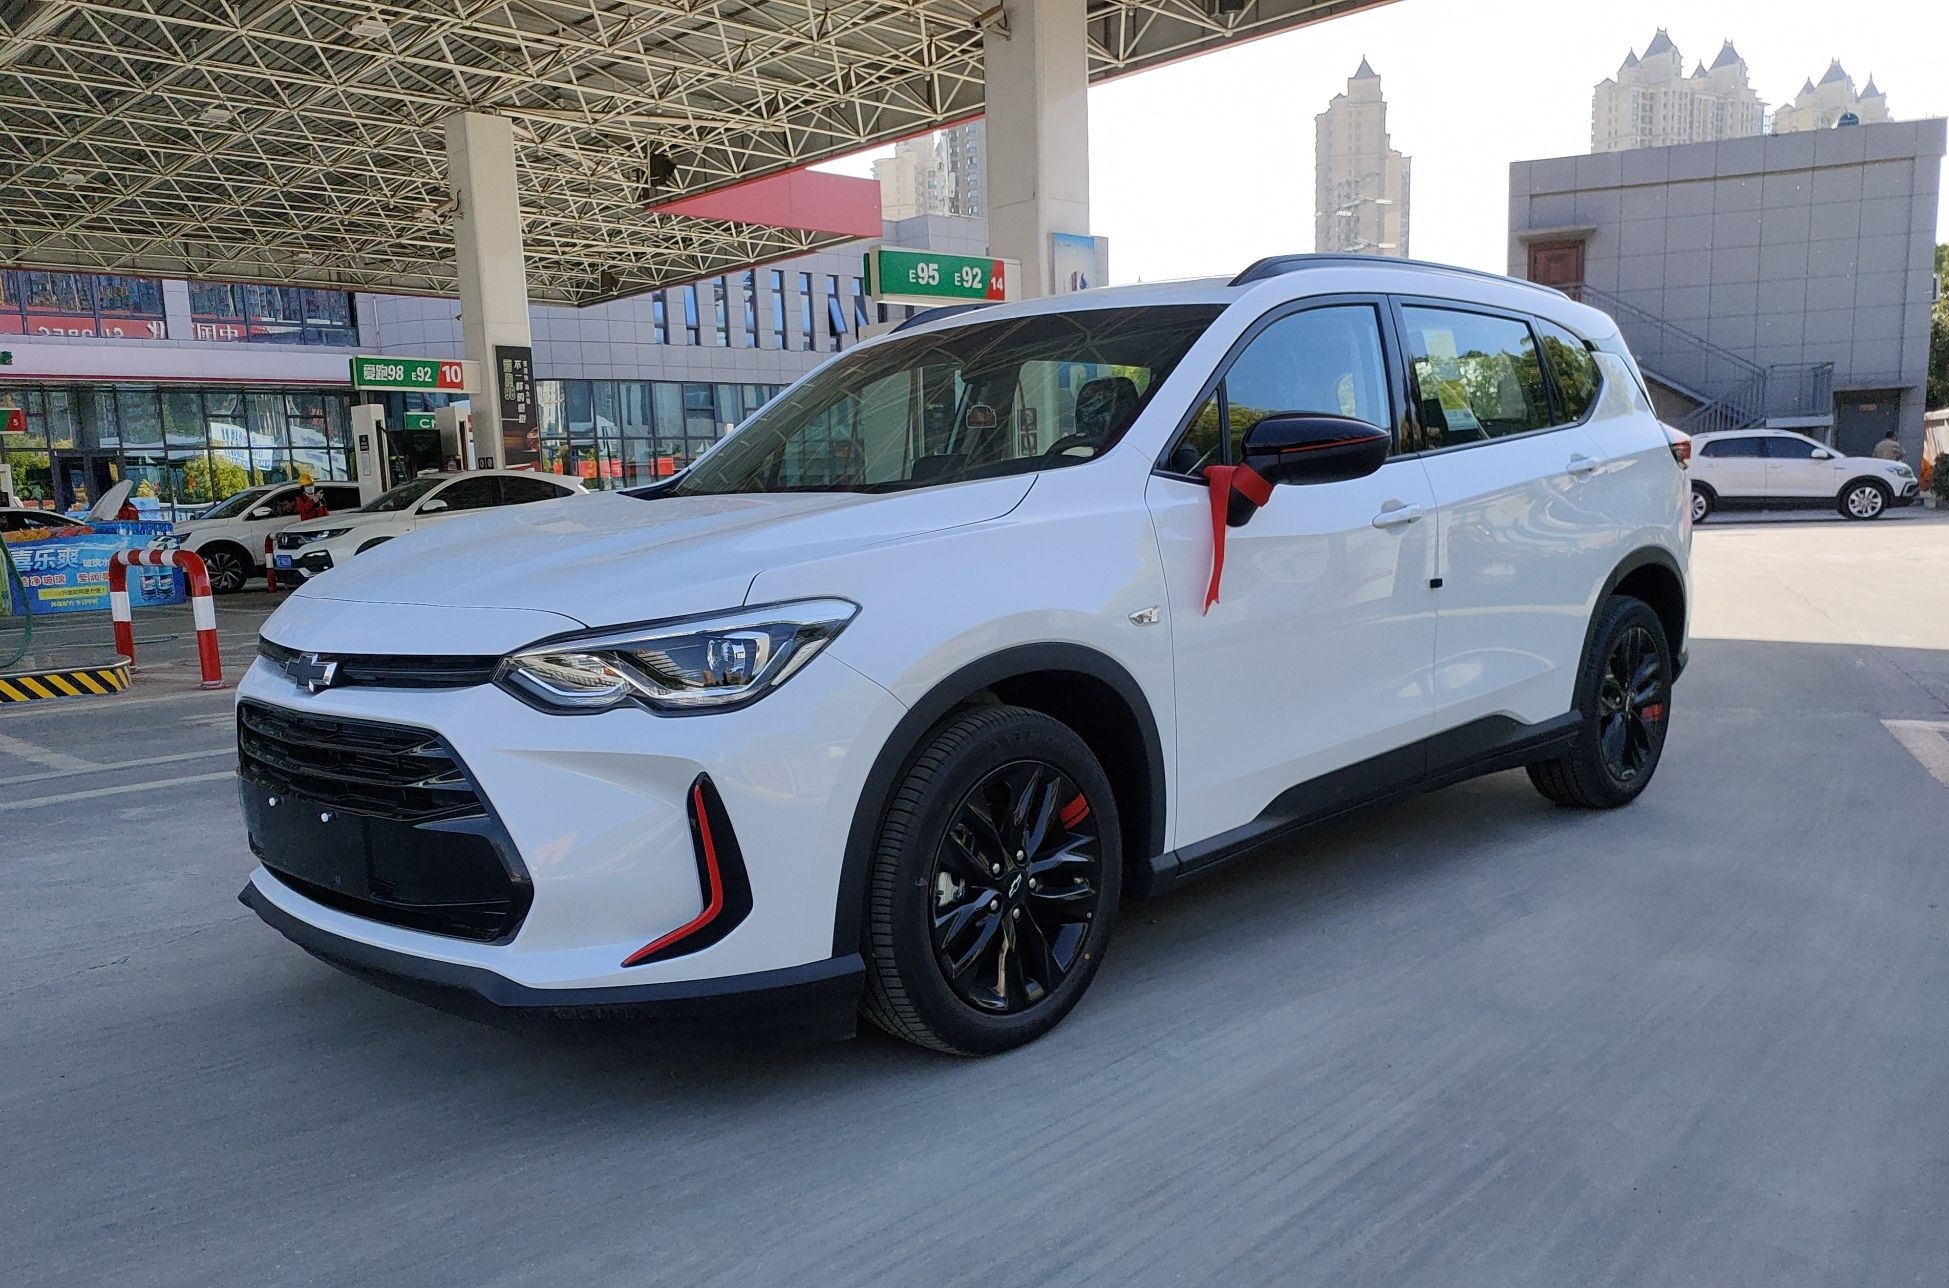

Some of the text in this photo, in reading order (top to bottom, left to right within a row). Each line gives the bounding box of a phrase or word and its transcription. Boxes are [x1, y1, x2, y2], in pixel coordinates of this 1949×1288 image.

[909, 263, 1004, 291] E95 E92 14
[363, 364, 462, 383] 爱跑98 E92 10
[11, 547, 80, 572] 喜乐爽
